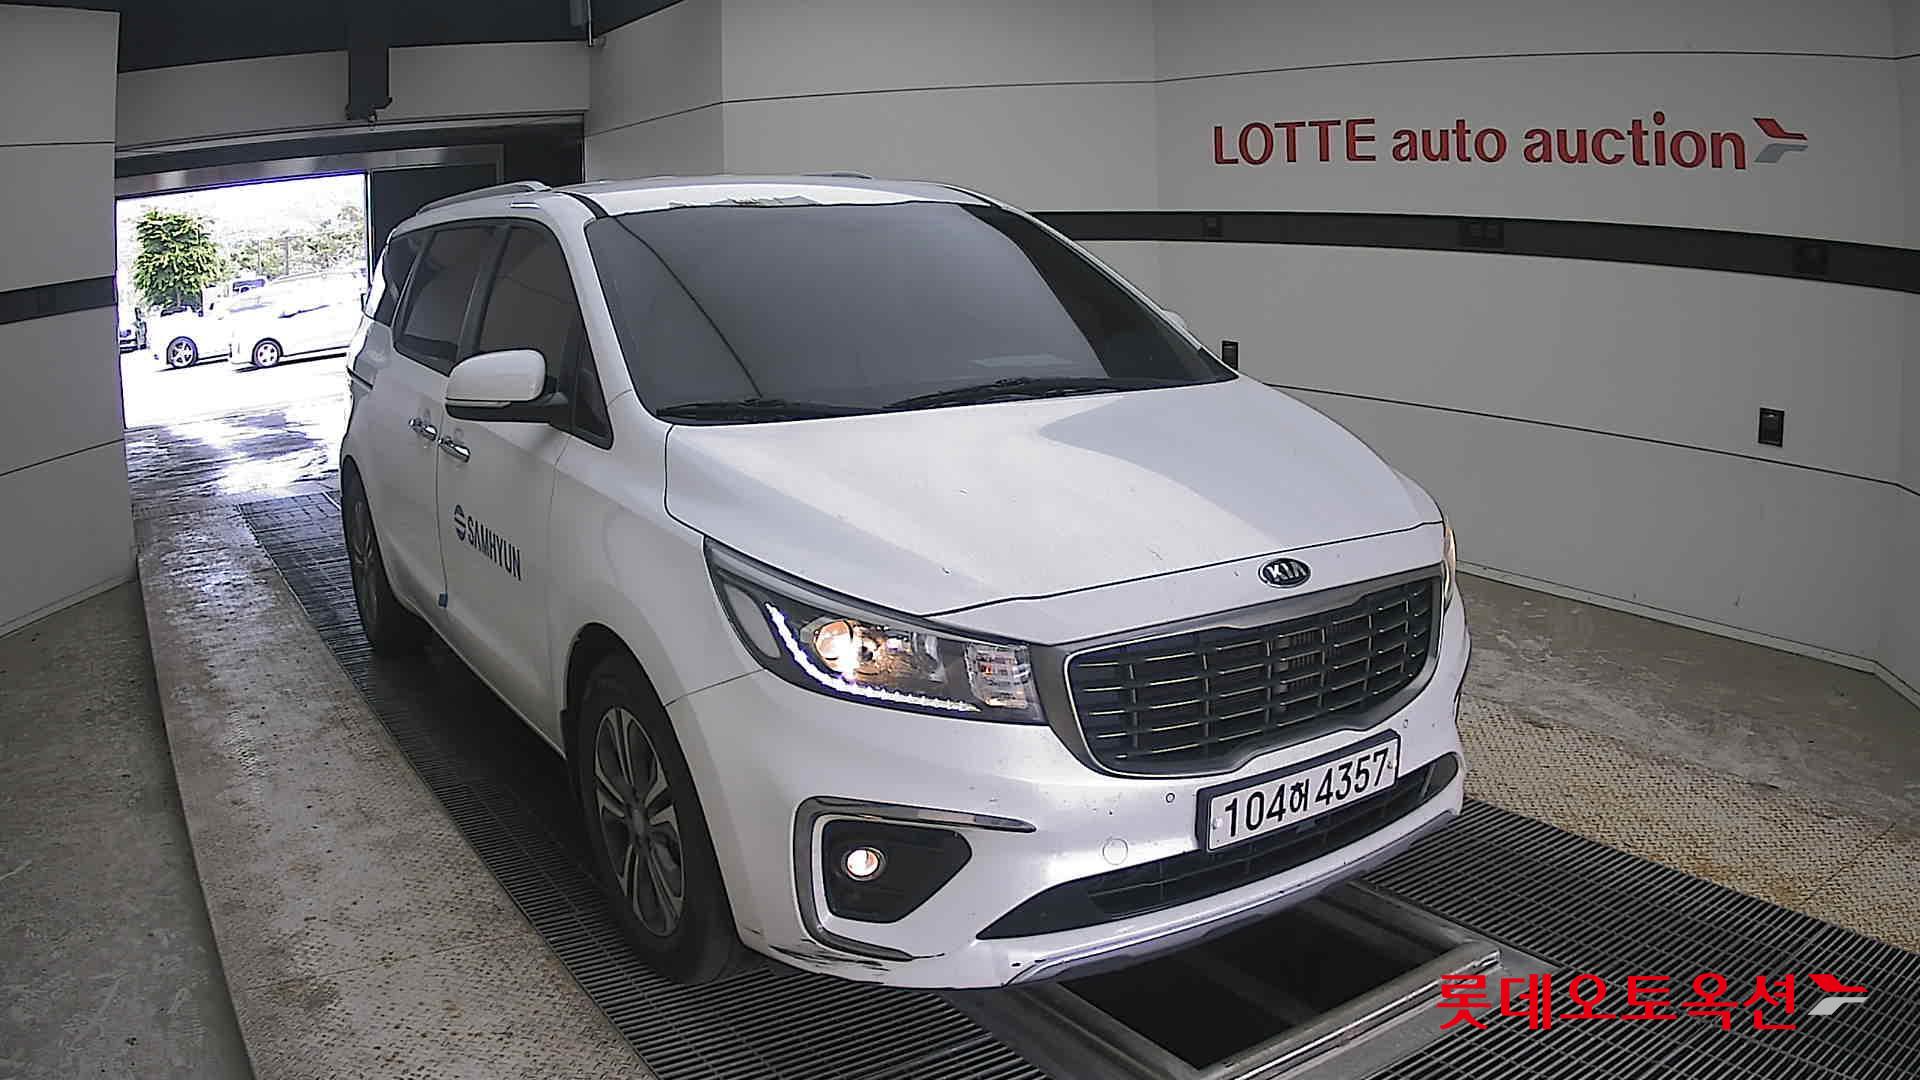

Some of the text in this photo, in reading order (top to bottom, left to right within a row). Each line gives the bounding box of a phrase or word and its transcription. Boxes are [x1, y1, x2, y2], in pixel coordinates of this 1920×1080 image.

[1214, 111, 1747, 170] LOTTE auto auction
[467, 515, 521, 581] SAMHYUN
[1225, 747, 1390, 838] 104허 4357
